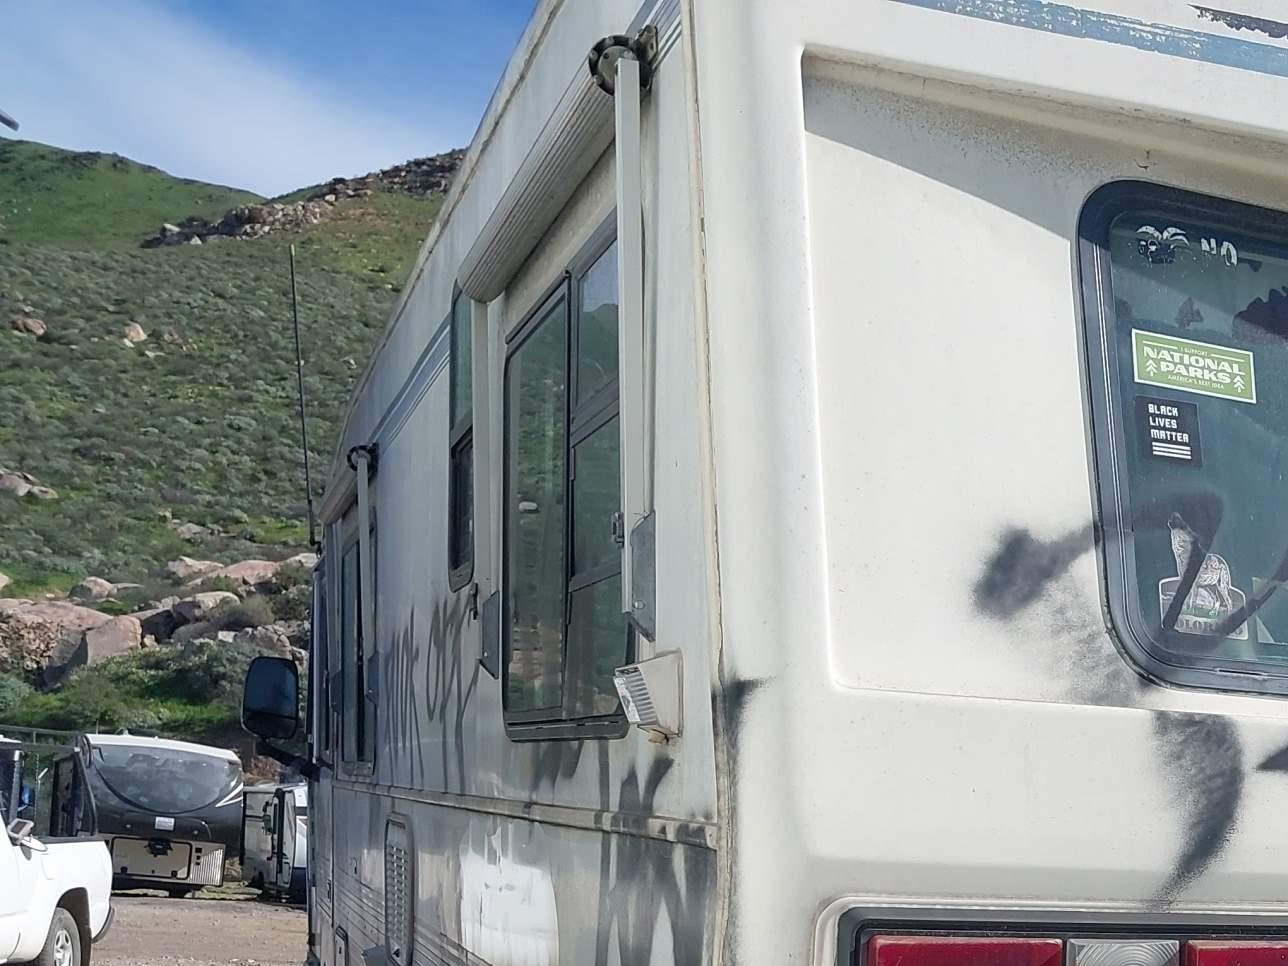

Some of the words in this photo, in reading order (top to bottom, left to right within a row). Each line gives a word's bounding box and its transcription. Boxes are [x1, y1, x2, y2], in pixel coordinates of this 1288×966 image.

[1143, 345, 1246, 375] NATIONAL
[1160, 361, 1232, 384] PARKS
[1148, 403, 1178, 417] BLACK
[1149, 416, 1178, 429] LIVES
[1150, 429, 1189, 443] MATTER
